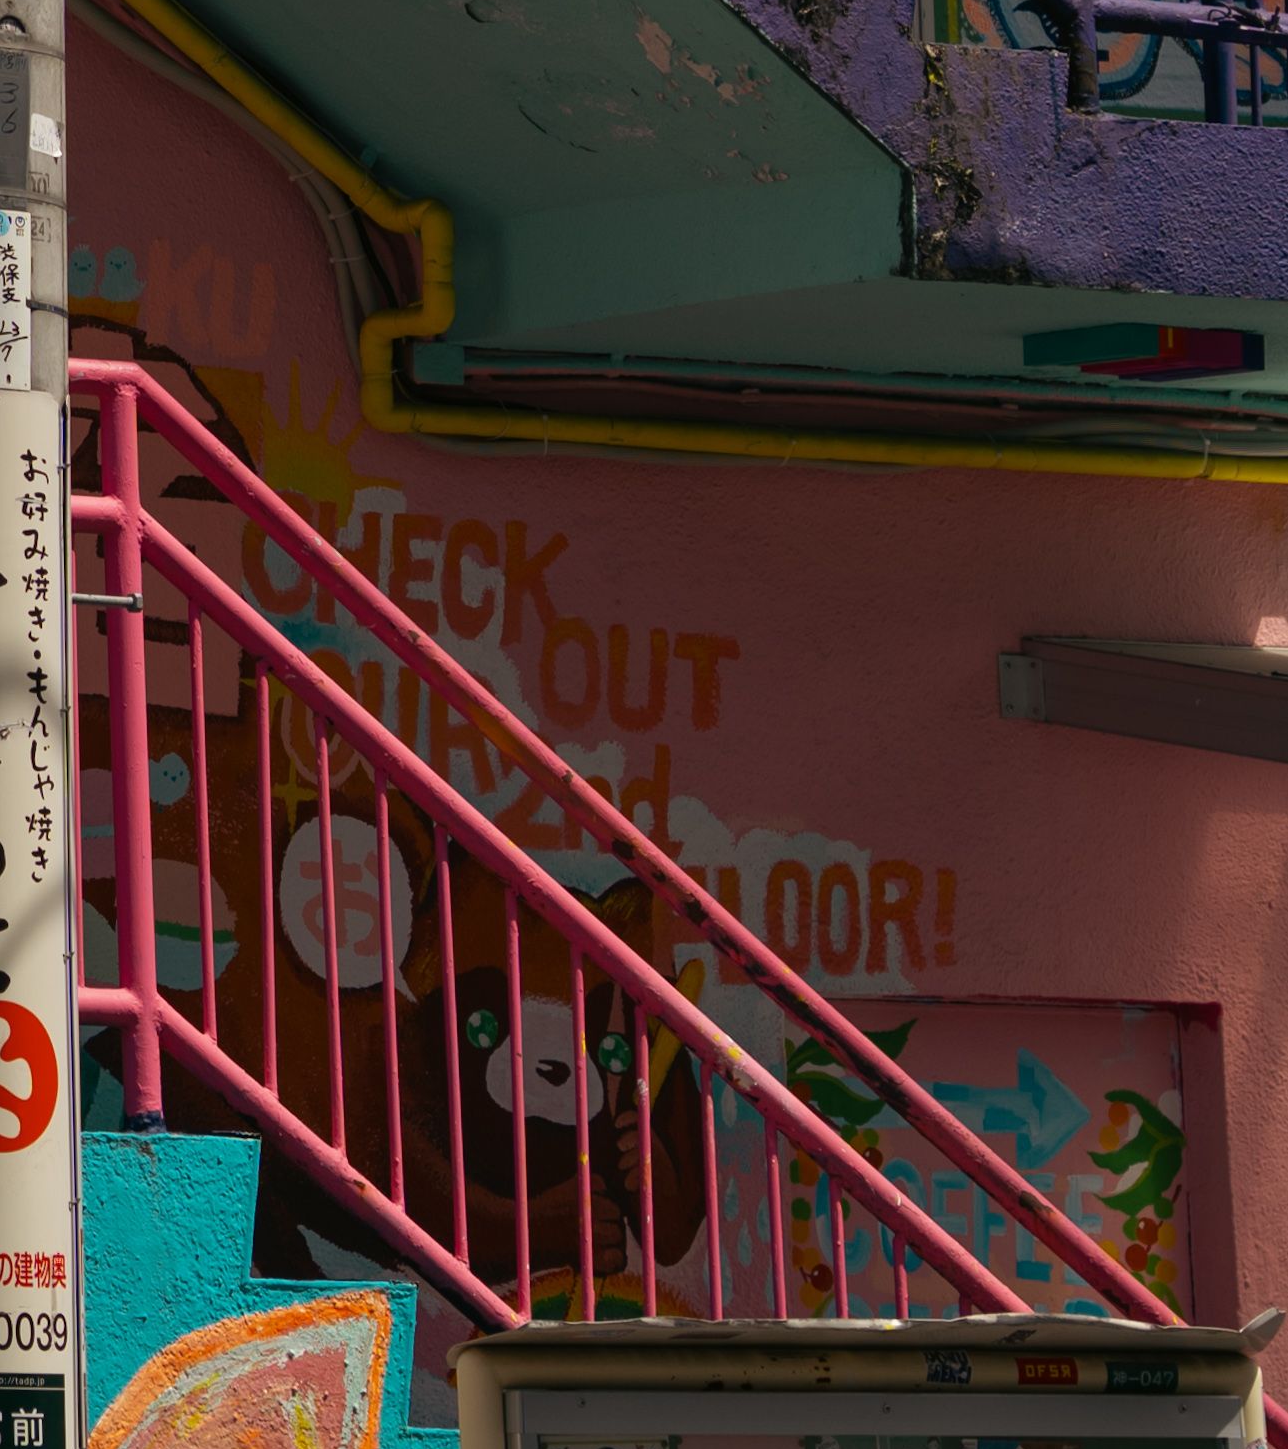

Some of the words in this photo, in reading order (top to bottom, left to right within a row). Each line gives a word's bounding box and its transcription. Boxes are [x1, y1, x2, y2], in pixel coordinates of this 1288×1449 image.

[20, 447, 56, 884] お好み焼き・もんじゃ焼き
[241, 501, 569, 642] CHECK
[540, 617, 740, 731] OUT
